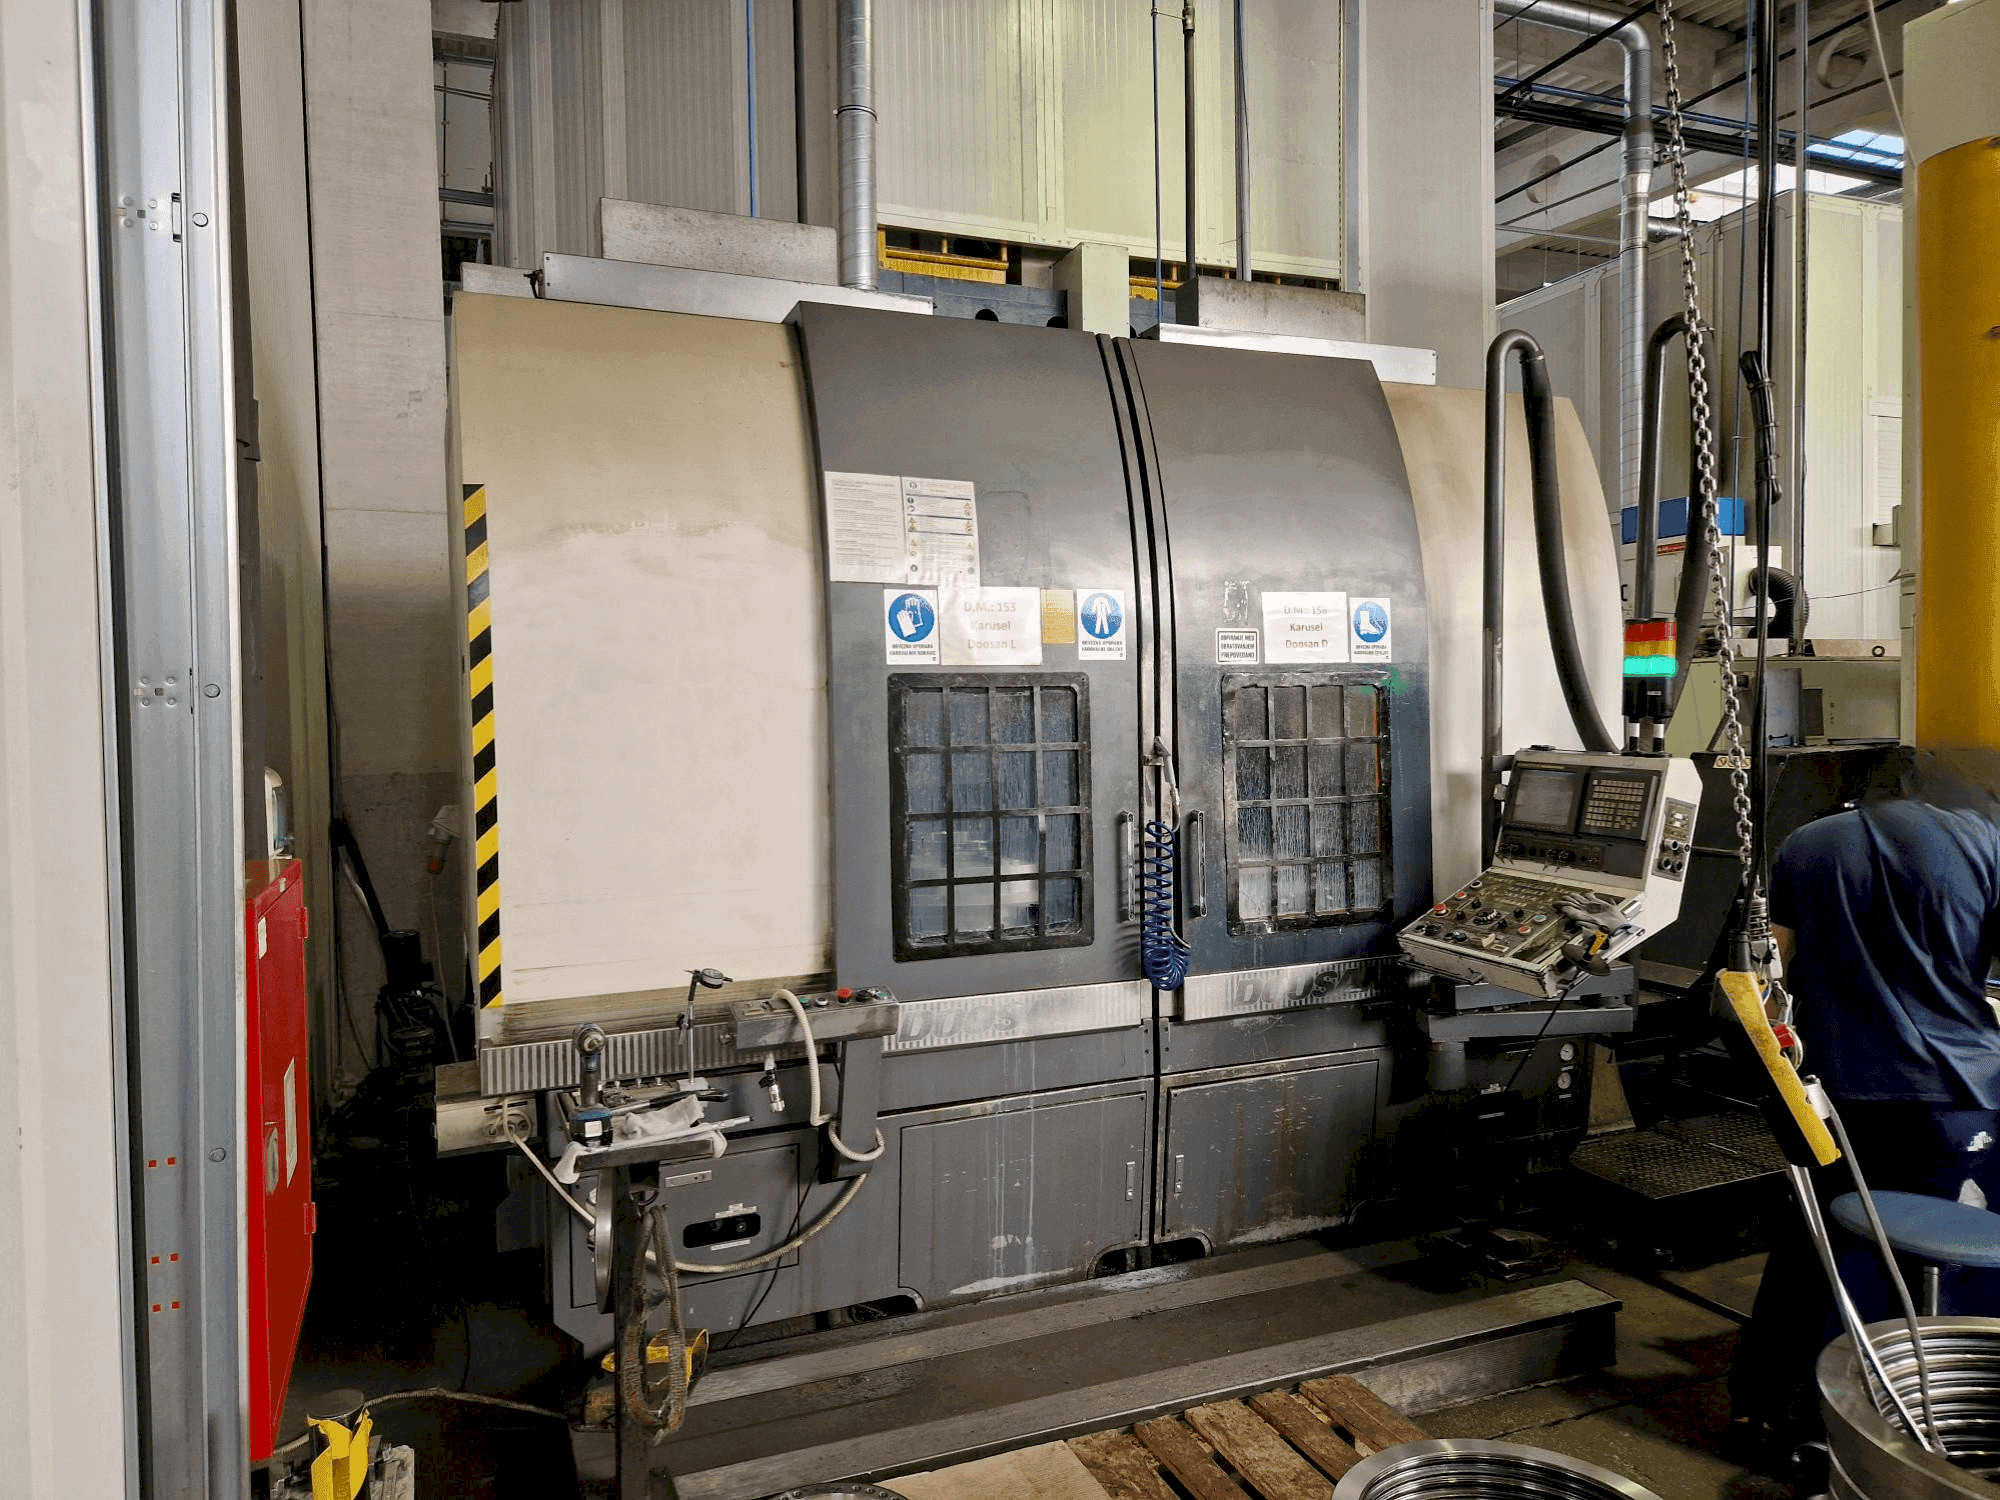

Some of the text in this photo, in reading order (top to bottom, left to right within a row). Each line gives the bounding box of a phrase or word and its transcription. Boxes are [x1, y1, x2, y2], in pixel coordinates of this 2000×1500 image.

[963, 602, 1017, 612] D.M.: 153
[971, 620, 1011, 631] Karusel
[1290, 620, 1323, 632] Karusel
[967, 639, 1017, 649] Doosan L
[1285, 639, 1329, 649] Doosan D
